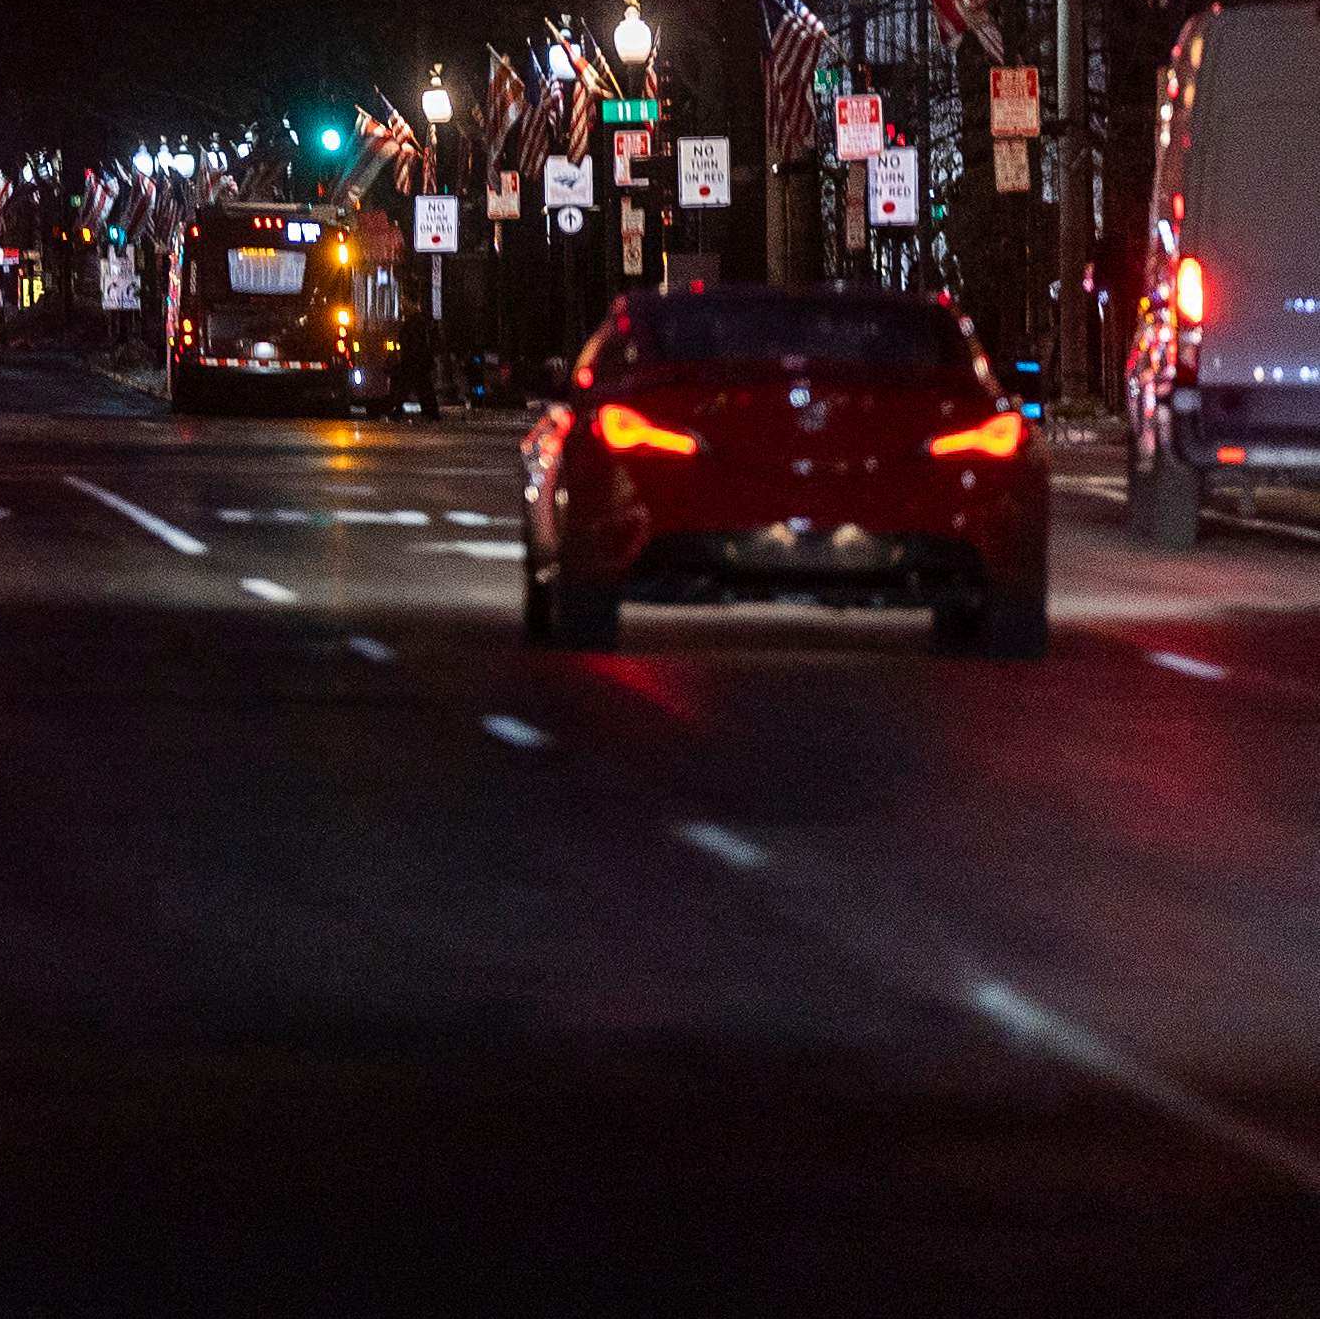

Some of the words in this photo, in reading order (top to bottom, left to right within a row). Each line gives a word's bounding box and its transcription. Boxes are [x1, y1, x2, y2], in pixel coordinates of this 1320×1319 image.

[693, 143, 714, 158] NO
[691, 159, 719, 170] TURN
[878, 152, 900, 169] NO
[684, 171, 699, 183] ON
[704, 172, 725, 183] RED
[874, 171, 905, 184] TURN
[889, 186, 912, 198] RED
[427, 200, 446, 211] NO
[419, 223, 433, 233] ON
